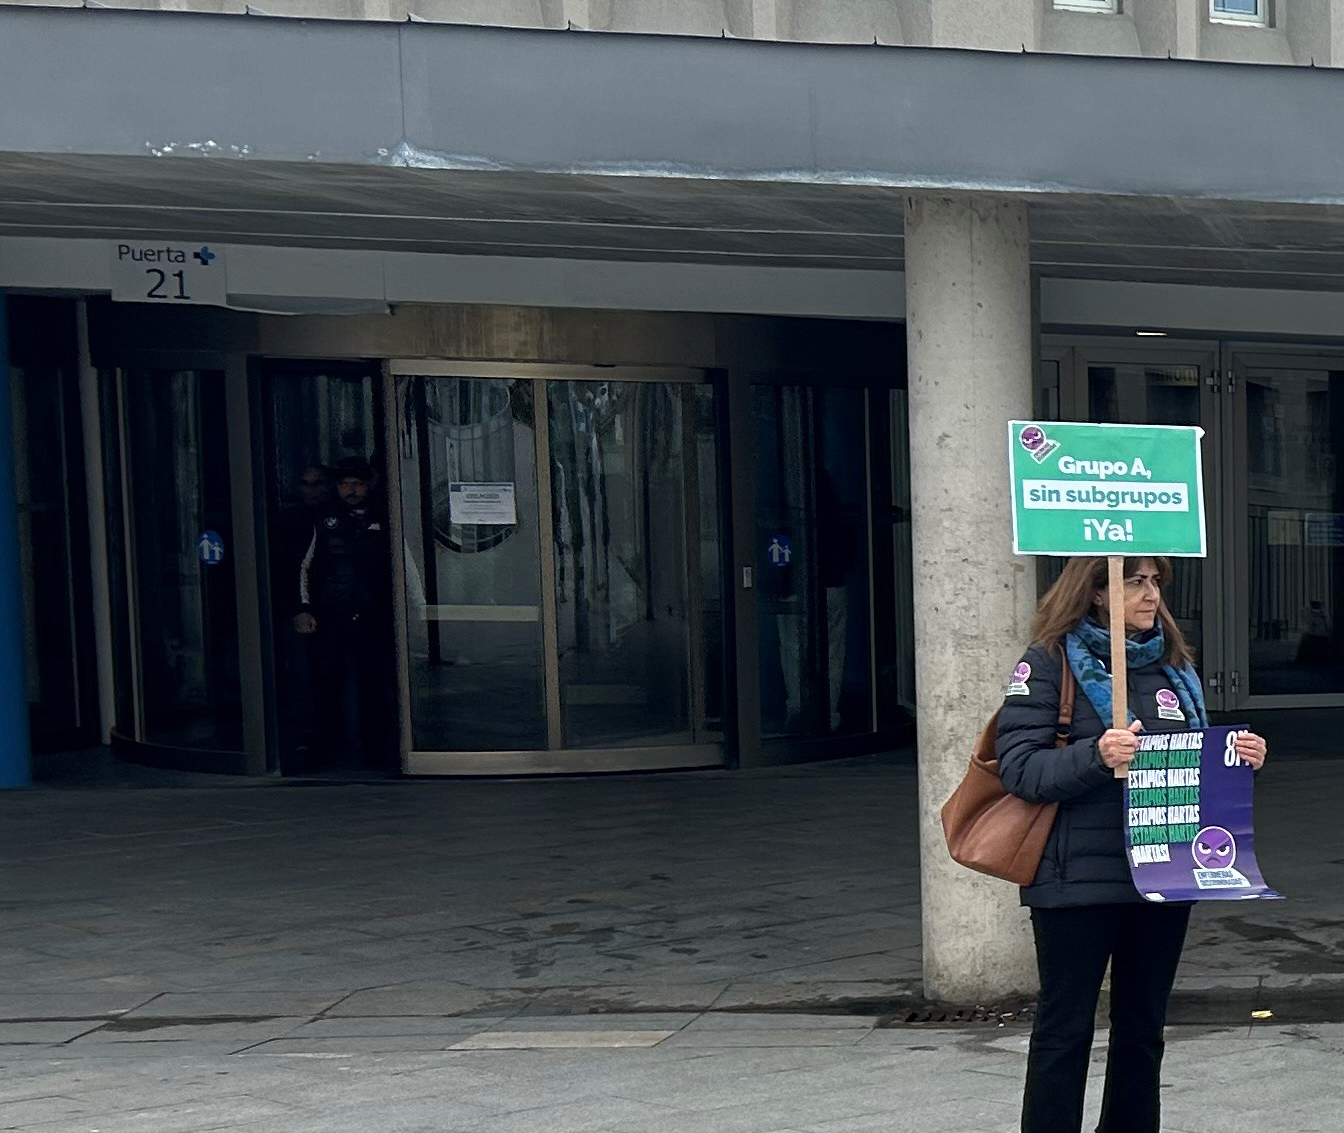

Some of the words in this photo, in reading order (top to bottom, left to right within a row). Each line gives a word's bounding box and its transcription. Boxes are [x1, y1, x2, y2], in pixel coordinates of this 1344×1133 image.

[118, 244, 186, 263] Puerta
[146, 268, 191, 300] 21
[1057, 455, 1128, 480] Grupo
[1130, 457, 1152, 480] A,
[1029, 484, 1061, 503] sin
[1065, 485, 1183, 509] subgrupos
[1083, 518, 1134, 542] ¡Ya!
[1136, 733, 1170, 751] STAMOS
[1170, 731, 1204, 750] HARTAS
[1167, 750, 1201, 768] HARTAS
[1128, 769, 1167, 789] ESTAMOS
[1167, 768, 1200, 787] HARTAS
[1129, 788, 1167, 807] ESTAMOS
[1167, 786, 1200, 806] HARTAS
[1128, 807, 1167, 827] ESTAMOS
[1167, 805, 1200, 824] HARTAS
[1130, 825, 1168, 845] ESTAMOS
